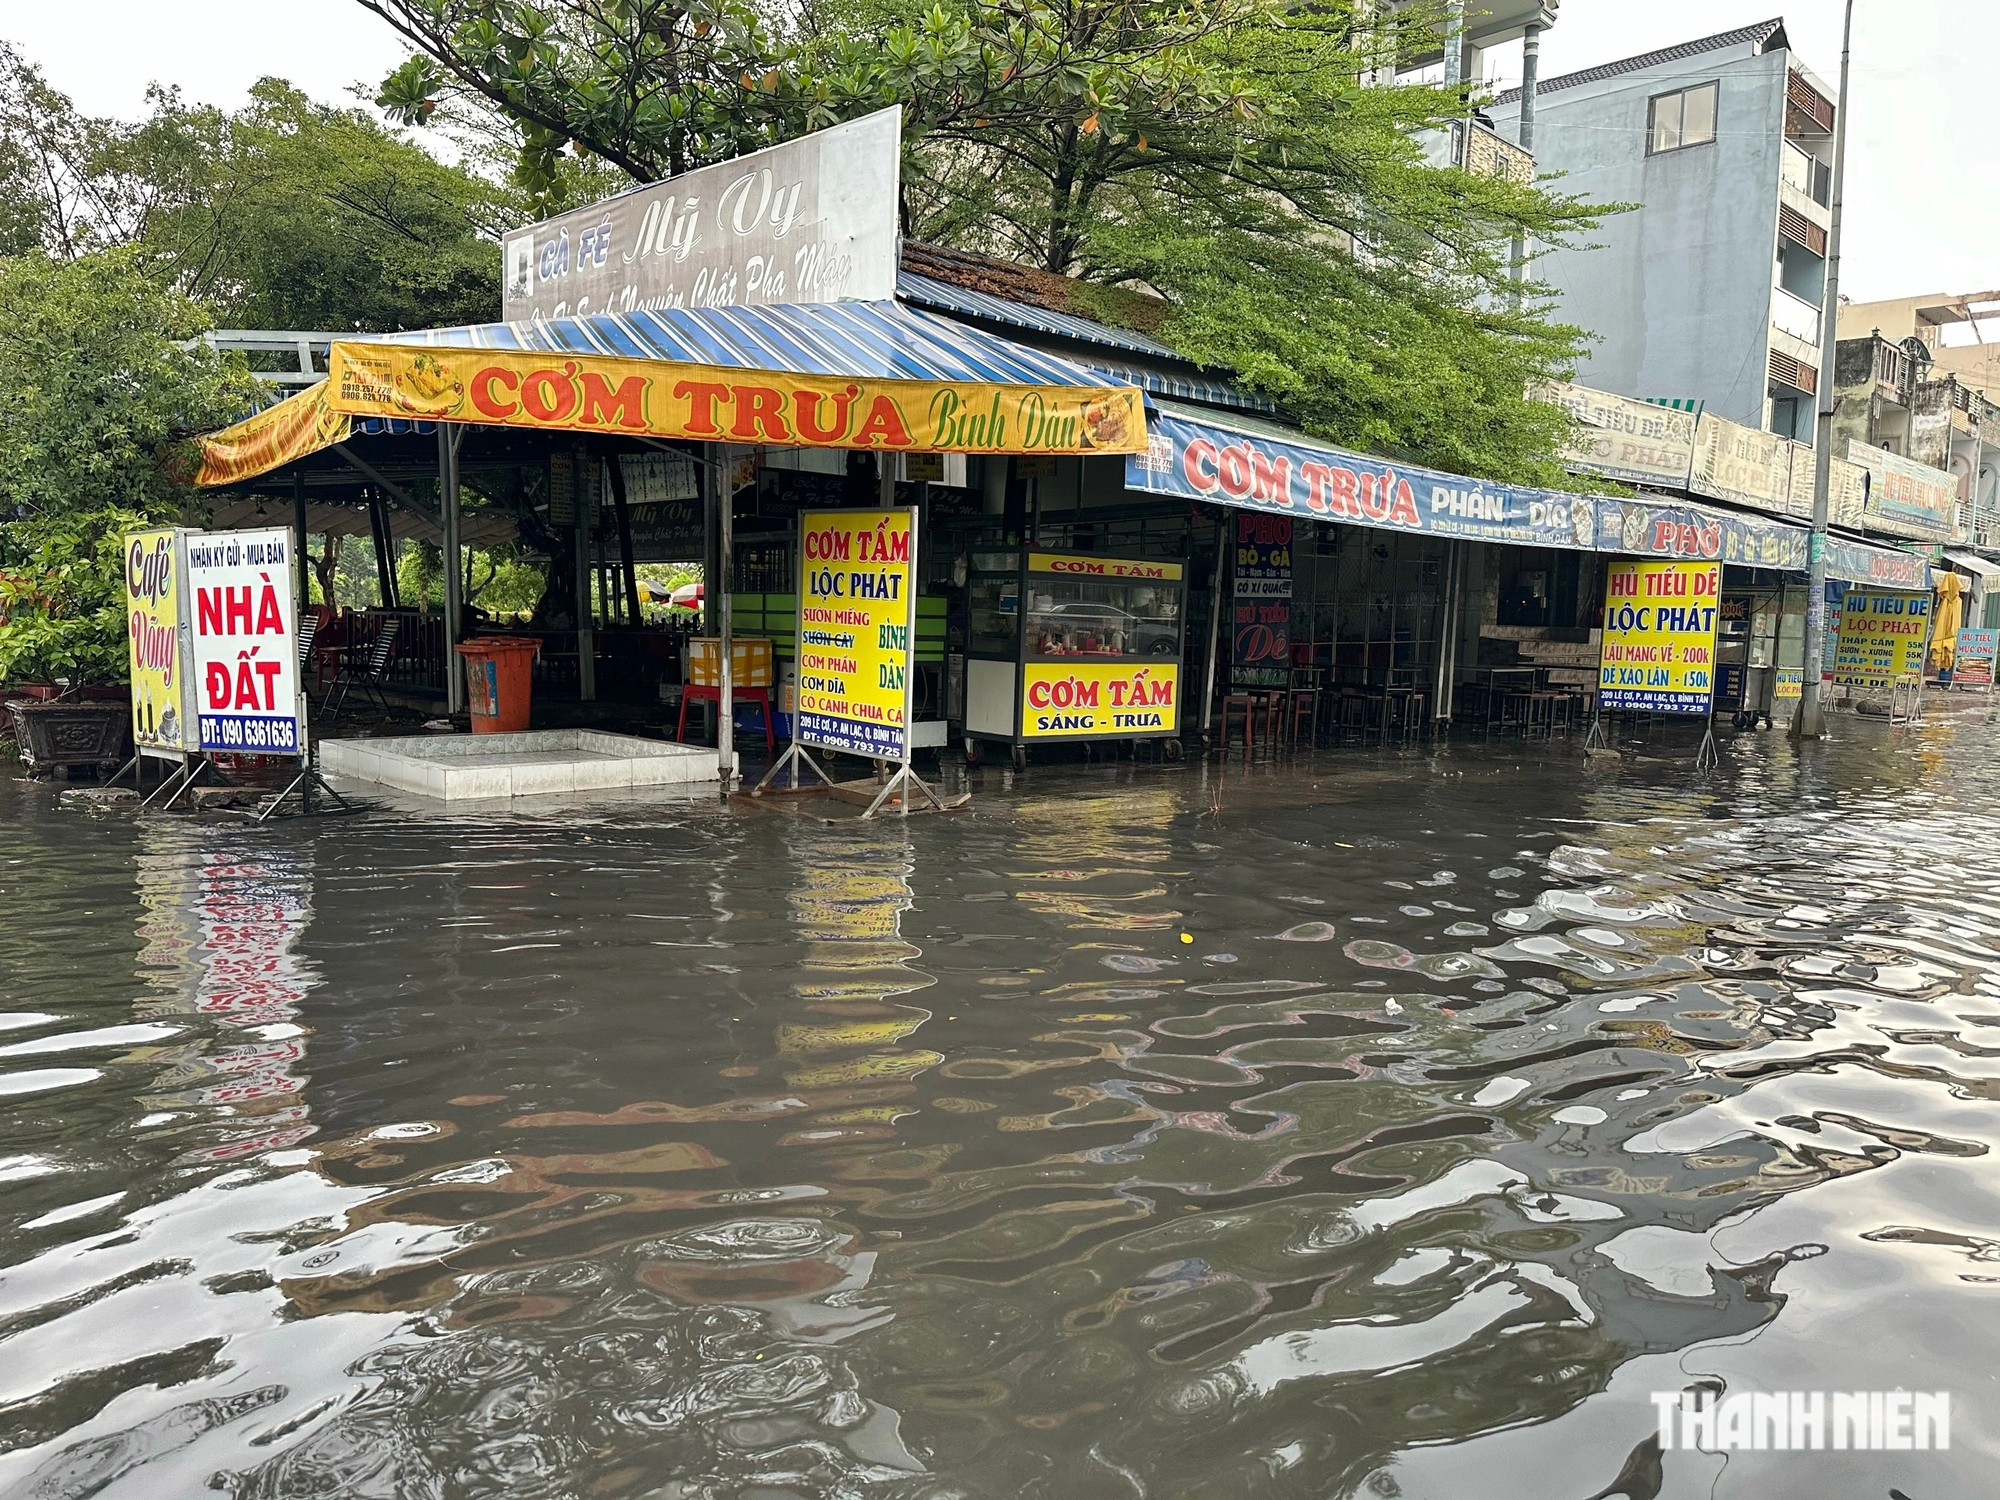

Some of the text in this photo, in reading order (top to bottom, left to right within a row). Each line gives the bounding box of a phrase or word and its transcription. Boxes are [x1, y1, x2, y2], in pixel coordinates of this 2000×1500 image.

[539, 167, 806, 282] CÀ FÉ Mỹ Vy
[746, 254, 787, 299] Pha
[794, 241, 852, 298] Máy
[470, 360, 1079, 449] CƠM TRƯA Bình Dân
[1183, 438, 1295, 510] CƠM
[1302, 461, 1423, 528] TRƯA
[1431, 484, 1504, 522] PHẦN
[1529, 499, 1568, 529] DĨA
[805, 516, 910, 563] CƠM TẤM
[1536, 530, 1554, 543] BÌNH
[1652, 518, 1723, 558] PHỞ
[190, 537, 284, 574] NHẬN KÝ GỬI MUA BÁN
[1050, 560, 1164, 578] CƠM TẤM
[1237, 544, 1291, 567] BÒ GÀ
[128, 536, 172, 607] Café
[810, 566, 902, 602] LỘC PHÁT
[1609, 565, 1718, 597] HỦ TIẾU DÊ
[1237, 579, 1249, 594] CÓ
[197, 572, 285, 636] NHÀ
[803, 606, 870, 626] SƯỜN MIẾNG
[1259, 598, 1290, 623] TIẾU
[1846, 592, 1867, 612] HỦ
[1872, 593, 1905, 615] TIẾU
[1908, 596, 1929, 616] DÊ
[1606, 602, 1650, 637] LỘC
[1656, 601, 1716, 633] PHÁT
[1847, 616, 1877, 635] LỘC
[1881, 617, 1922, 635] PHÁT
[878, 617, 907, 651] BÌNH
[1235, 623, 1288, 662] Dê
[1907, 641, 1923, 649] 55K
[131, 610, 176, 688] Võng
[802, 654, 825, 670] CƠM
[1625, 645, 1657, 662] MANG
[1682, 646, 1709, 664] 200k
[1873, 657, 1921, 669] DÊ 70K
[1905, 651, 1922, 659] 55K
[206, 645, 281, 711] ĐẤT
[801, 675, 825, 692] CƠM
[878, 657, 905, 691] DÂN
[1602, 663, 1709, 688] DÊ XÀO LĂN 150k
[1869, 678, 1889, 688] DÊ
[1028, 668, 1174, 710] CƠM TẤM
[1601, 690, 1613, 699] 209
[1614, 689, 1622, 700] LÊ
[1635, 692, 1642, 701] P.
[1643, 692, 1653, 701] AN
[1677, 692, 1694, 704] BÌNH
[1695, 693, 1709, 704] TÂN
[800, 693, 815, 709] CÓ
[818, 697, 849, 715] CANH
[851, 702, 884, 721] CHUA
[887, 706, 903, 723] CÁ
[1603, 700, 1704, 712] ĐT: 0906 793 725
[201, 718, 294, 747] ĐT: 090 6361636
[800, 715, 812, 728] 209
[812, 715, 820, 730] LÊ
[832, 721, 839, 733] P.
[840, 722, 849, 735] AN
[850, 723, 864, 740] LẠC,
[873, 725, 890, 743] BÌNH
[890, 728, 904, 745] TÂN
[1037, 712, 1162, 731] SÁNG TRƯA
[803, 731, 901, 758] ĐT: 0906 793 725
